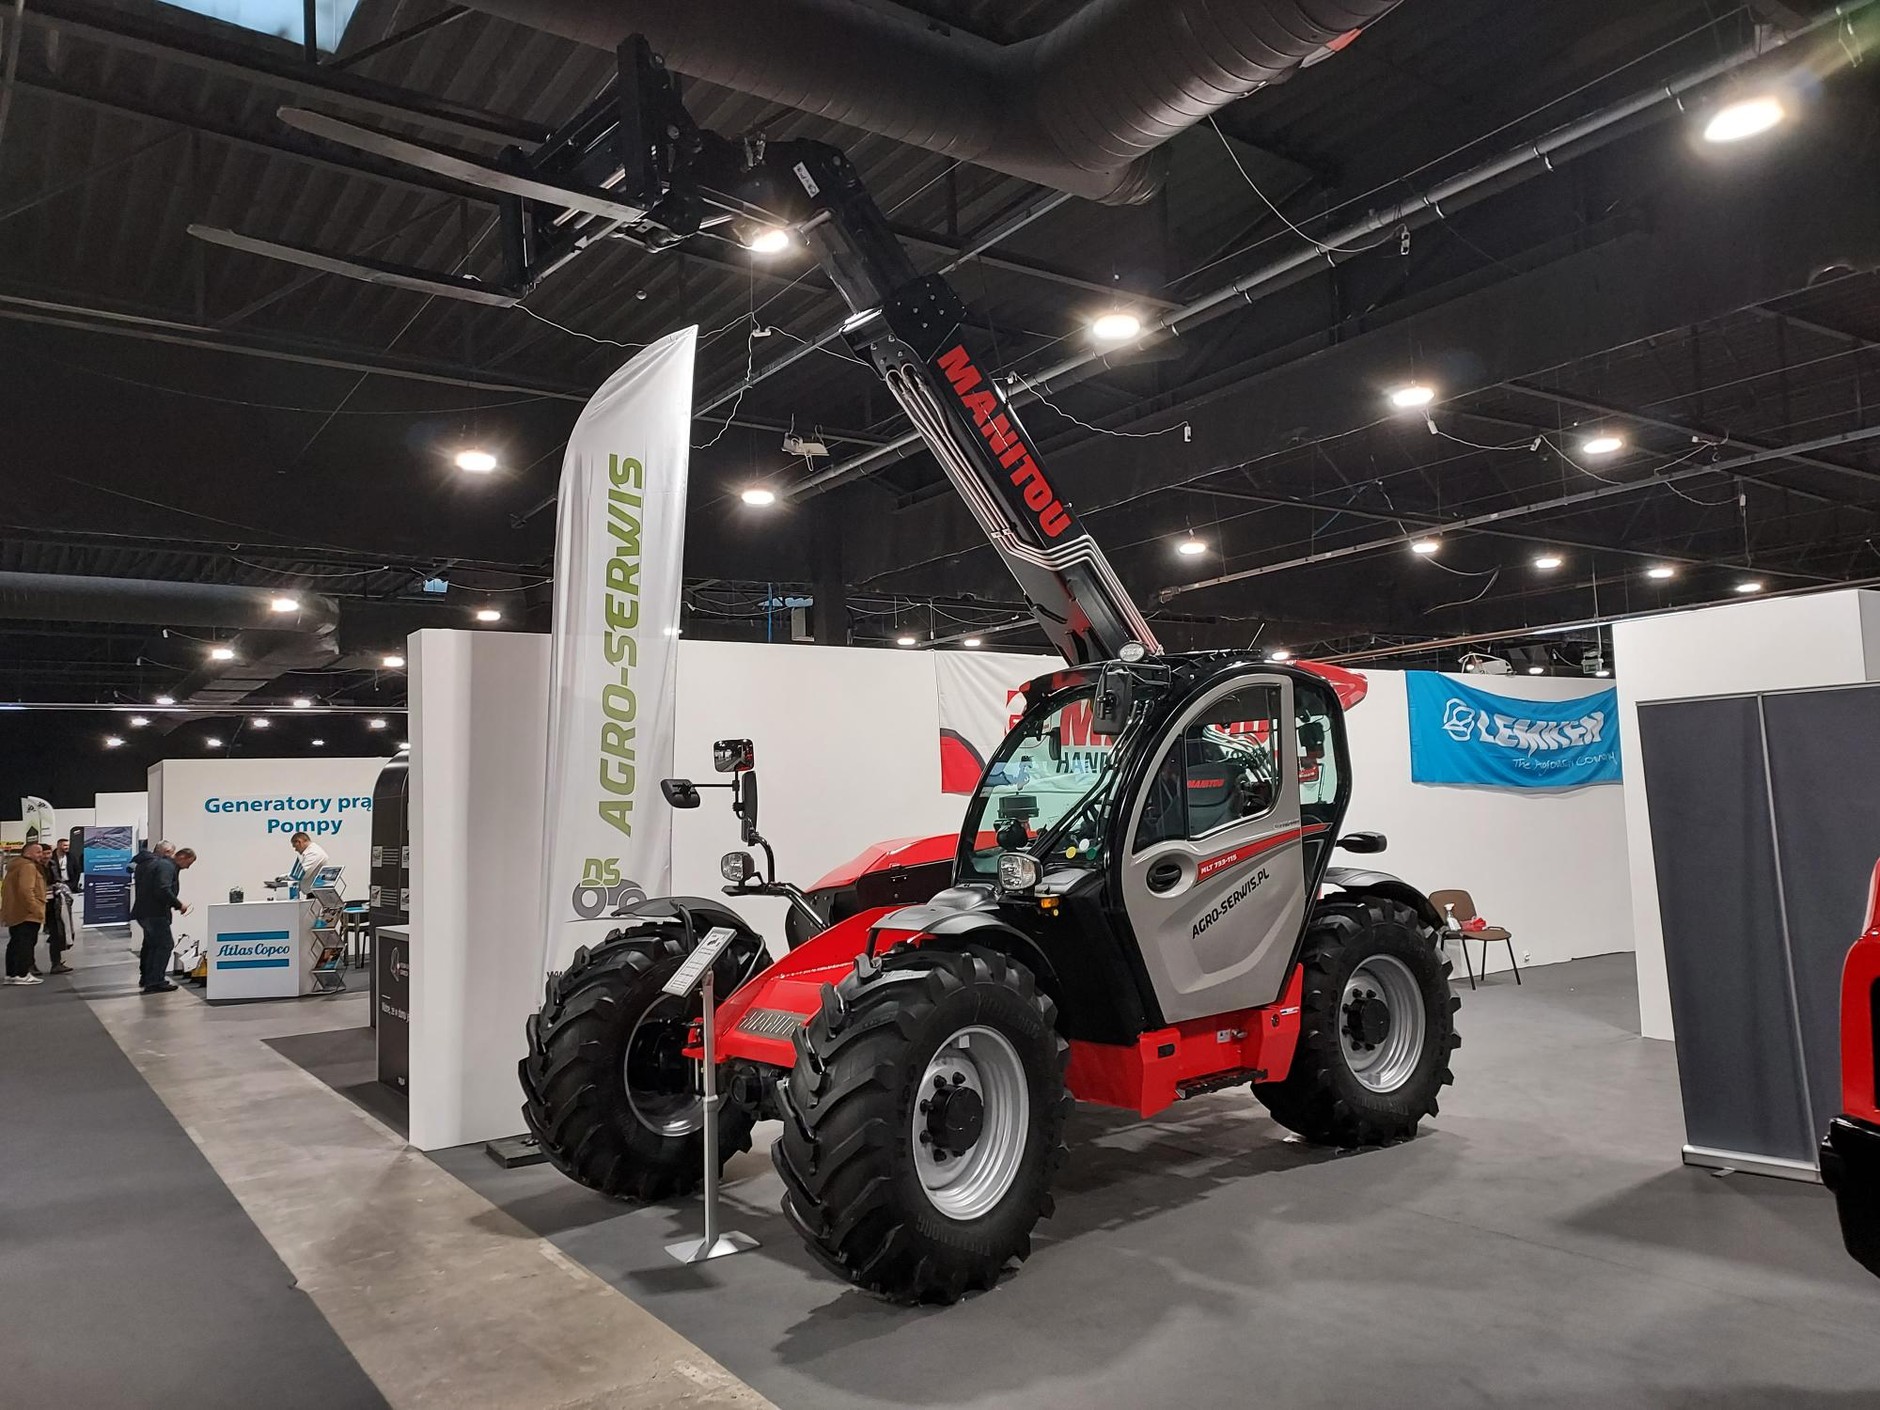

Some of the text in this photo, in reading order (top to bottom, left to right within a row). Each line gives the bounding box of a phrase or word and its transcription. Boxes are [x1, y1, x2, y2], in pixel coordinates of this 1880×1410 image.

[937, 345, 1072, 538] MANITOU
[599, 453, 643, 838] AGRO-SERWIS
[1476, 710, 1605, 758] LEMKEN
[1512, 758, 1531, 770] The
[205, 796, 372, 813] Generatory prą
[267, 819, 343, 835] Pompy
[1192, 868, 1270, 939] AGRO-SERWIS.PL
[216, 943, 290, 957] Atlas Copco
